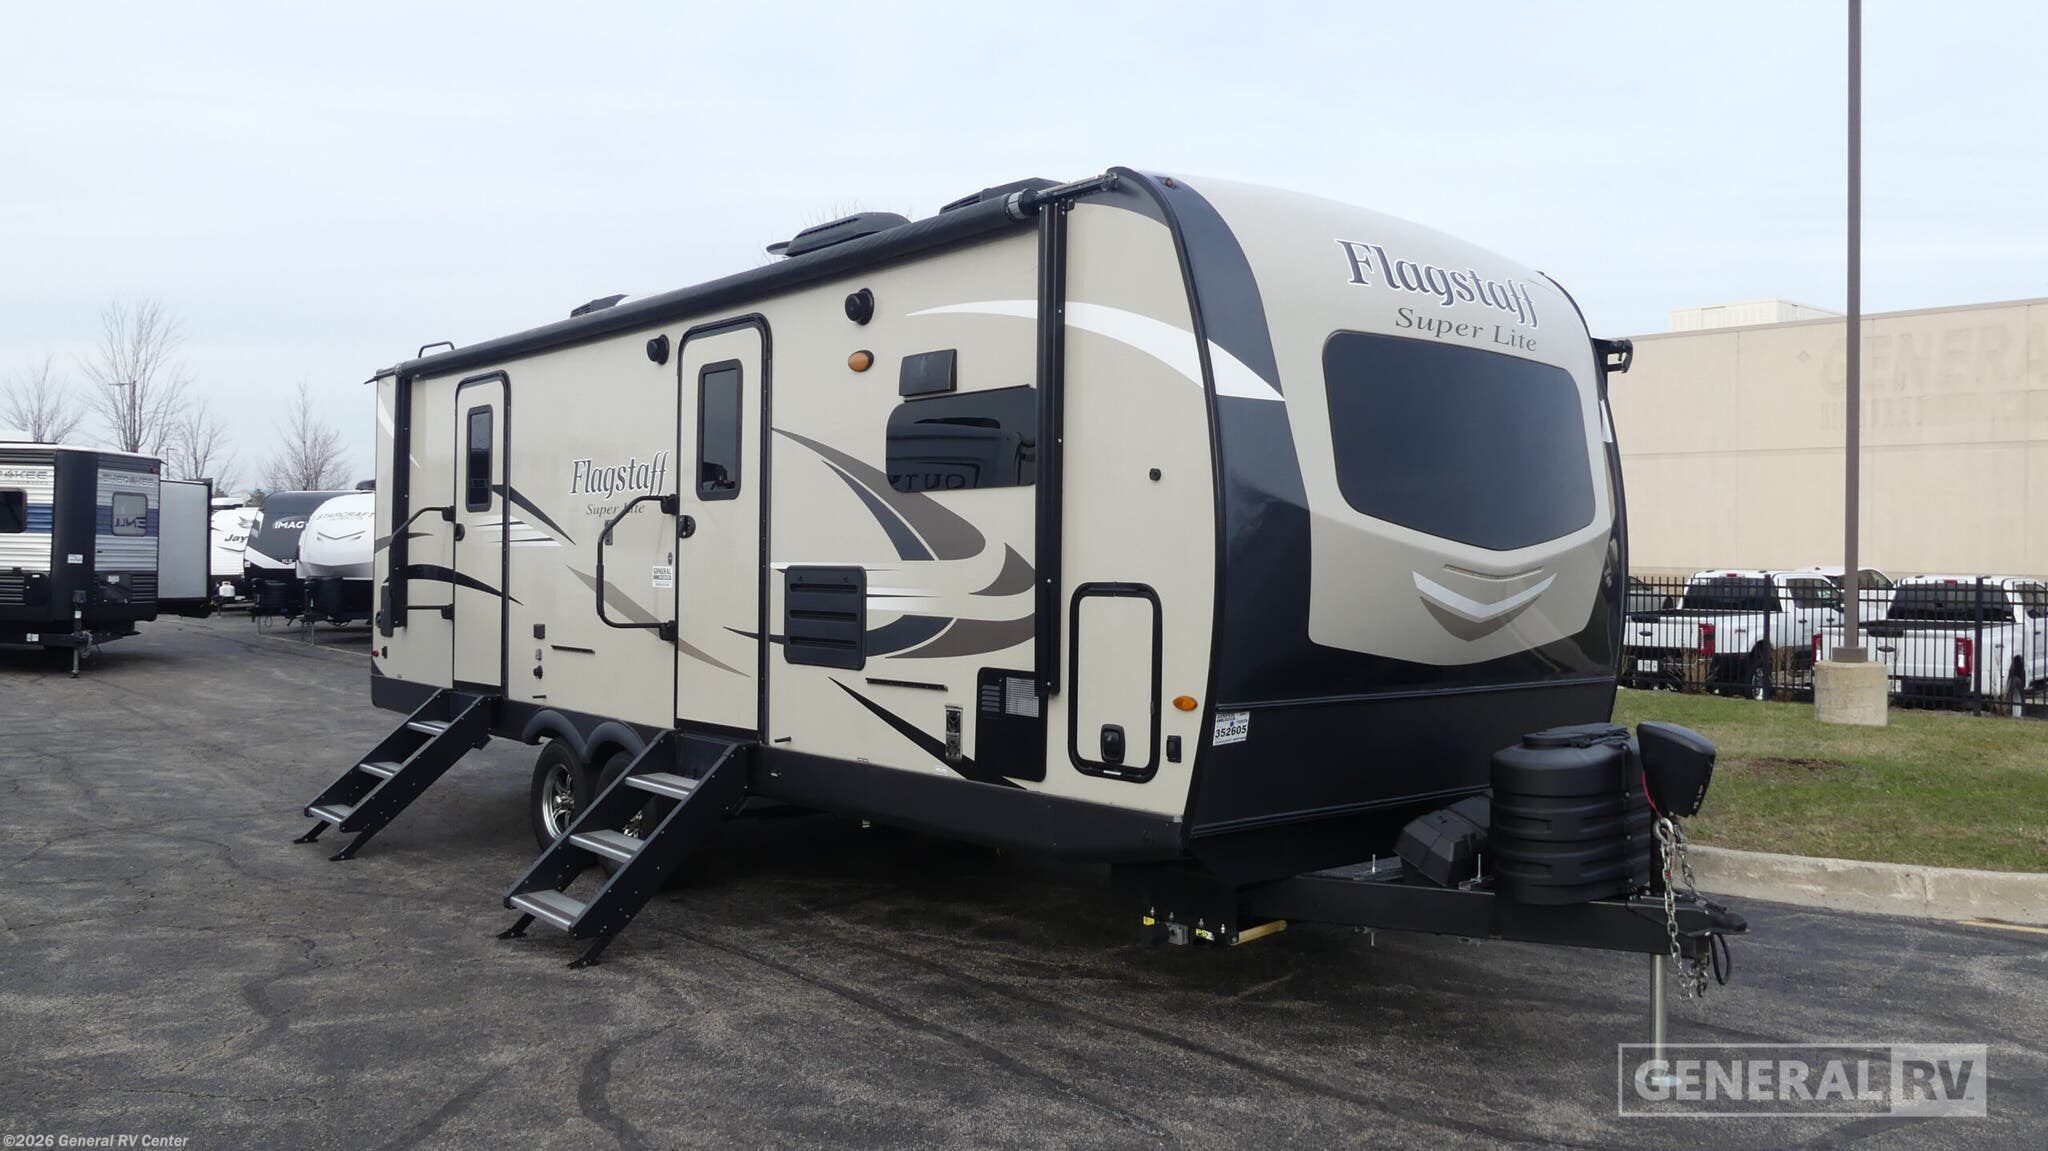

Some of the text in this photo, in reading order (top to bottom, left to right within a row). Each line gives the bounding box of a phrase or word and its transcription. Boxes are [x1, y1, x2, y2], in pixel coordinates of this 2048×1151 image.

[1335, 239, 1538, 328] Flagstaff
[1395, 306, 1538, 352] Super Lite
[570, 450, 670, 500] Flagstaff
[586, 503, 620, 518] Super
[1215, 724, 1247, 739] 352605
